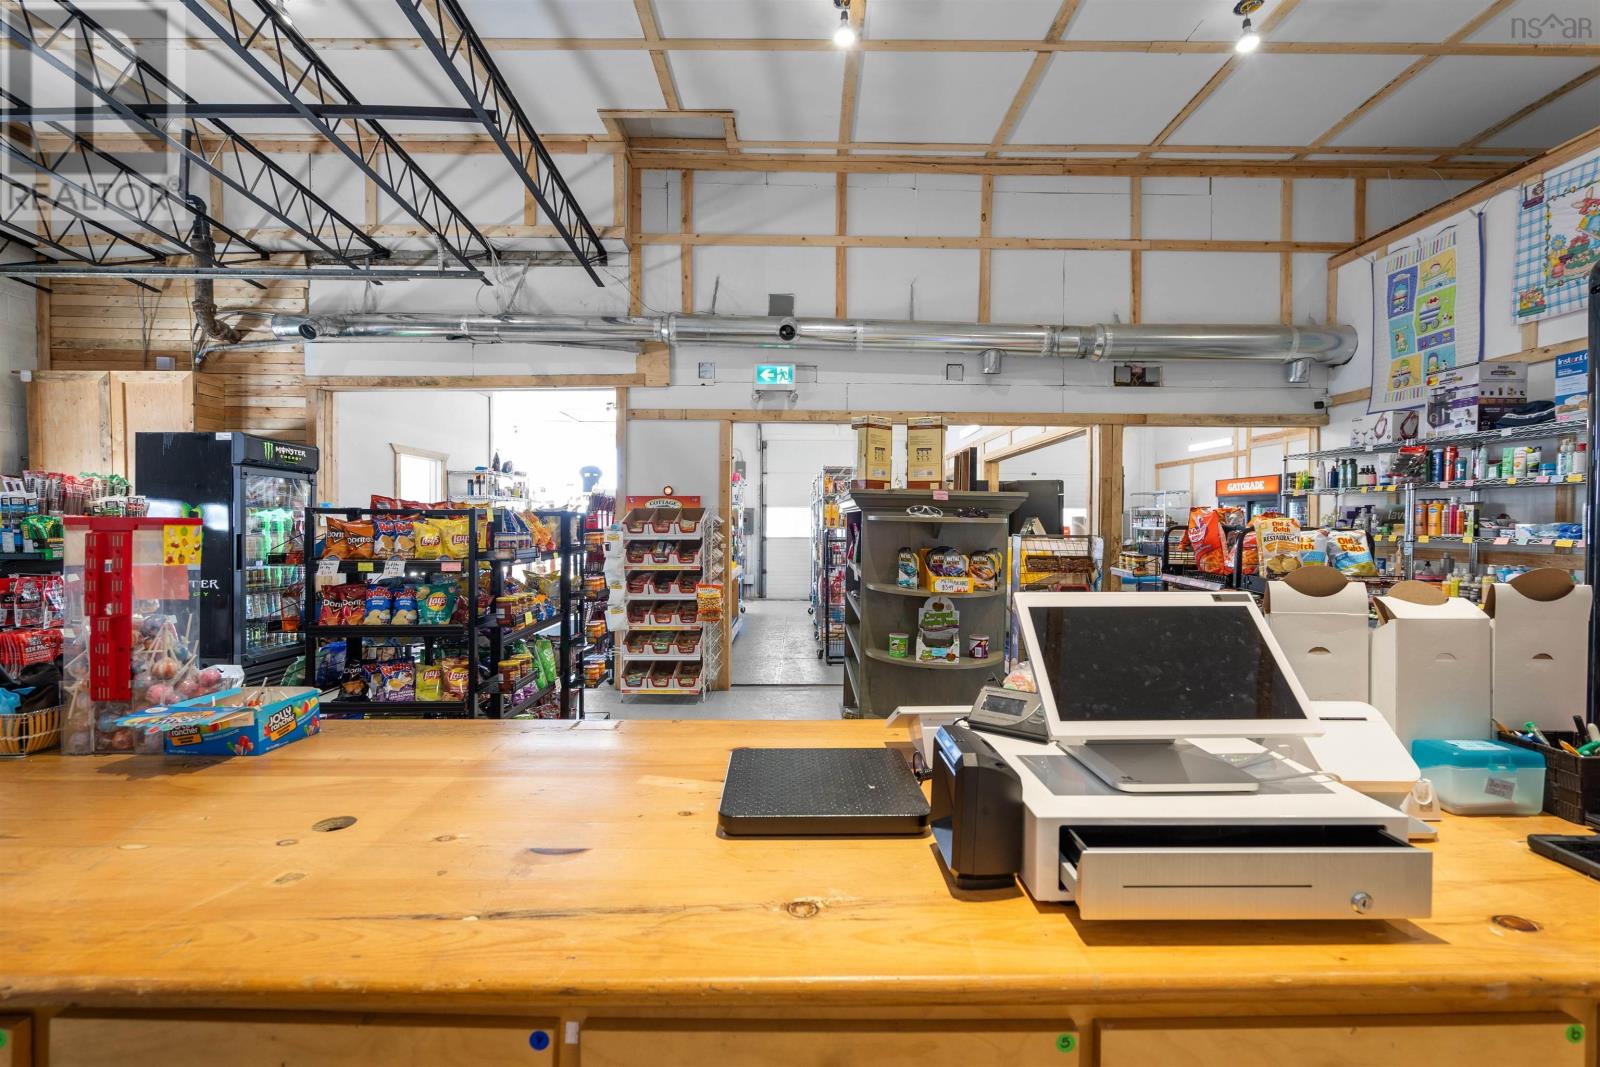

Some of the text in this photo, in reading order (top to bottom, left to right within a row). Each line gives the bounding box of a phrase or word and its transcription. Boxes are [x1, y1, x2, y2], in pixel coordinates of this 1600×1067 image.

[275, 445, 307, 458] MONSTER
[1227, 480, 1265, 492] GATORADE
[269, 705, 293, 727] JOLLY
[1060, 1036, 1071, 1049] 5
